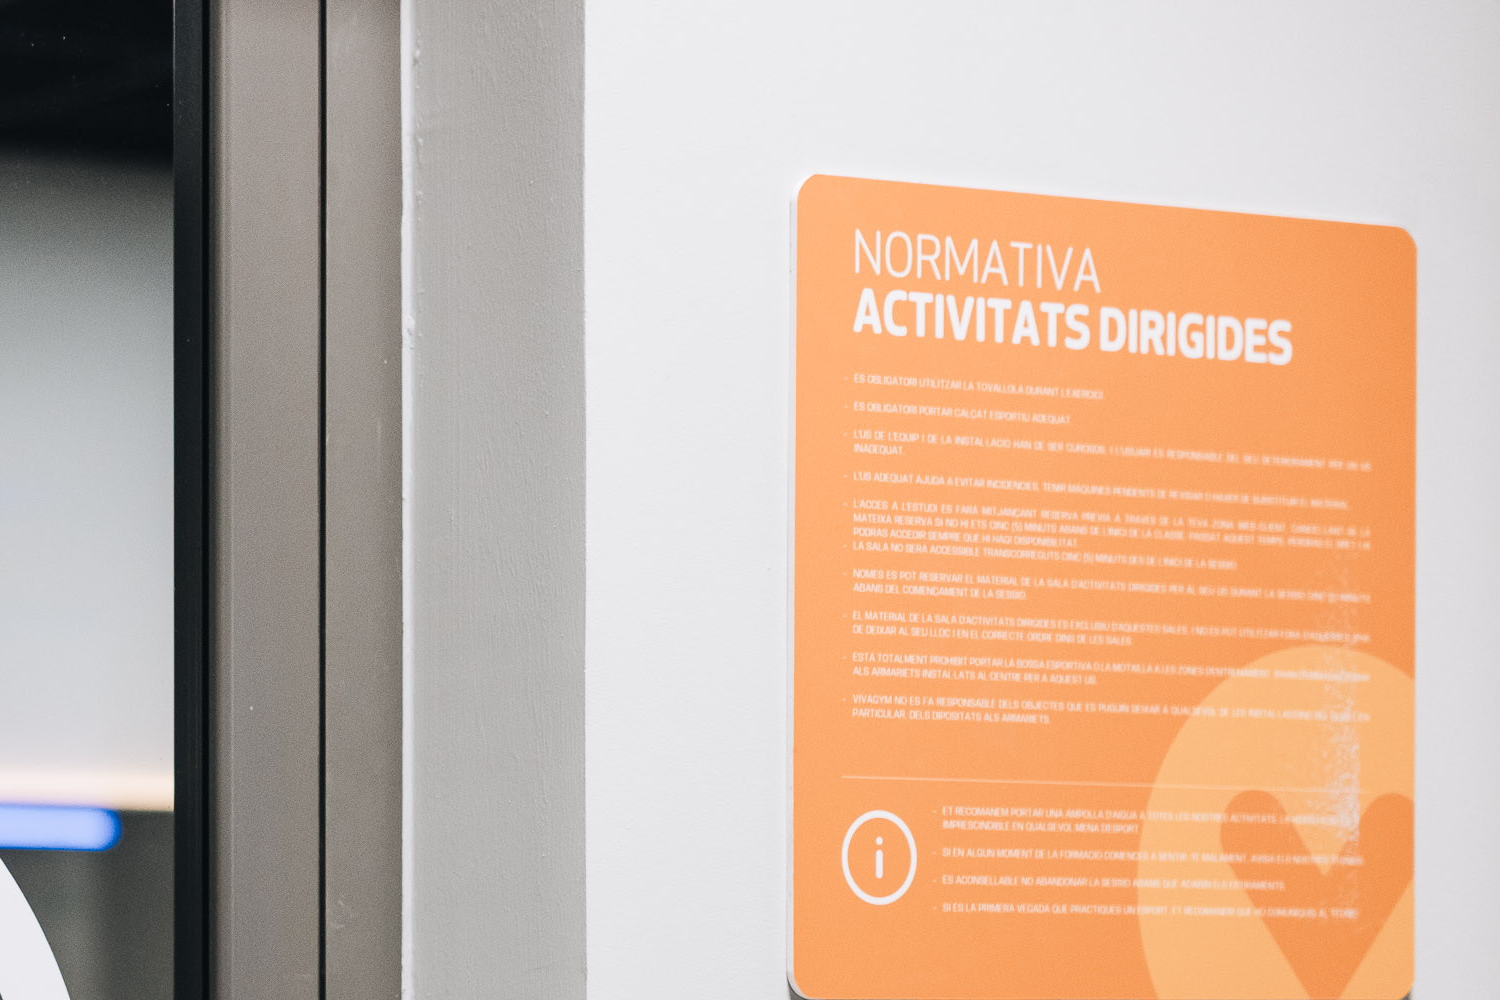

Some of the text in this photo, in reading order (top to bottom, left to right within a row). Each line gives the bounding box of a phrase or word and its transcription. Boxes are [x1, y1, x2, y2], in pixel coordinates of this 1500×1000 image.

[854, 227, 1102, 294] NORMATIVA
[853, 287, 1293, 366] ACTIVITATS DIRIGIDES
